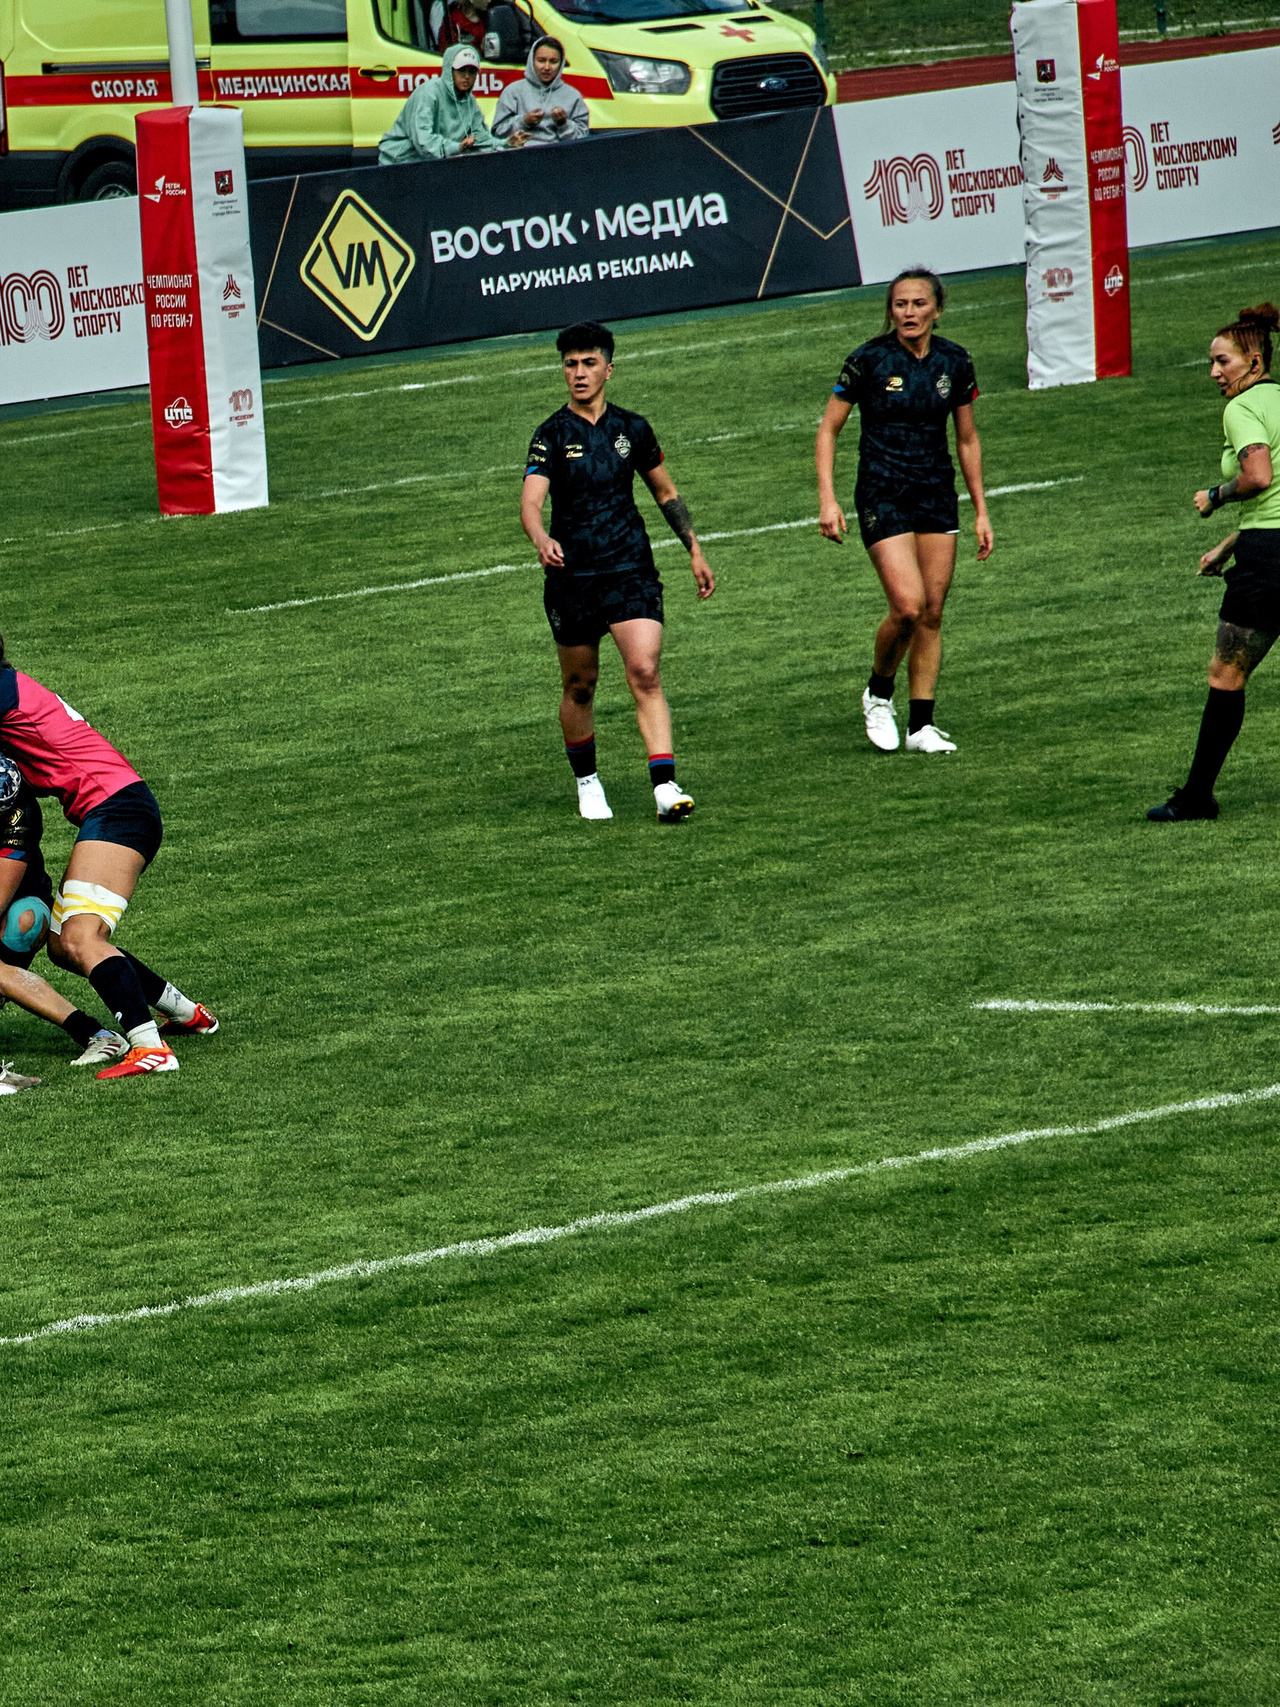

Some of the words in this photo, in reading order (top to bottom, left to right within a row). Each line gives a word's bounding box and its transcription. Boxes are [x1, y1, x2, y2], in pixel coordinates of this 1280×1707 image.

[91, 79, 158, 98] СКОРАЯ
[218, 73, 351, 97] МЕДИЦИНСКАЯ
[398, 73, 504, 94] ПОЩЬ
[1150, 121, 1169, 143] ЛЕТ
[945, 149, 965, 171] ЛЕТ
[1152, 136, 1237, 167] МОСКОВСКОМУ
[863, 153, 944, 227] 100
[948, 165, 1025, 194] МОСКОВСКОМ
[1155, 165, 1199, 190] СПОРТУ
[951, 193, 995, 218] СПОРТУ
[67, 265, 89, 288] ЛЕТ
[323, 238, 392, 296] VM
[480, 263, 593, 296] НАРУЖНАЯ
[597, 250, 694, 280] РЕКЛАМА
[146, 274, 193, 289] ЧЕМПИОНАТ
[70, 283, 145, 313] МОСКОВСКО
[155, 295, 187, 309] РОССИИ
[73, 311, 121, 338] СПОРТУ
[151, 315, 162, 328] ПО
[163, 313, 194, 328] РЕГБИ-7
[164, 407, 193, 421] ЦПС
